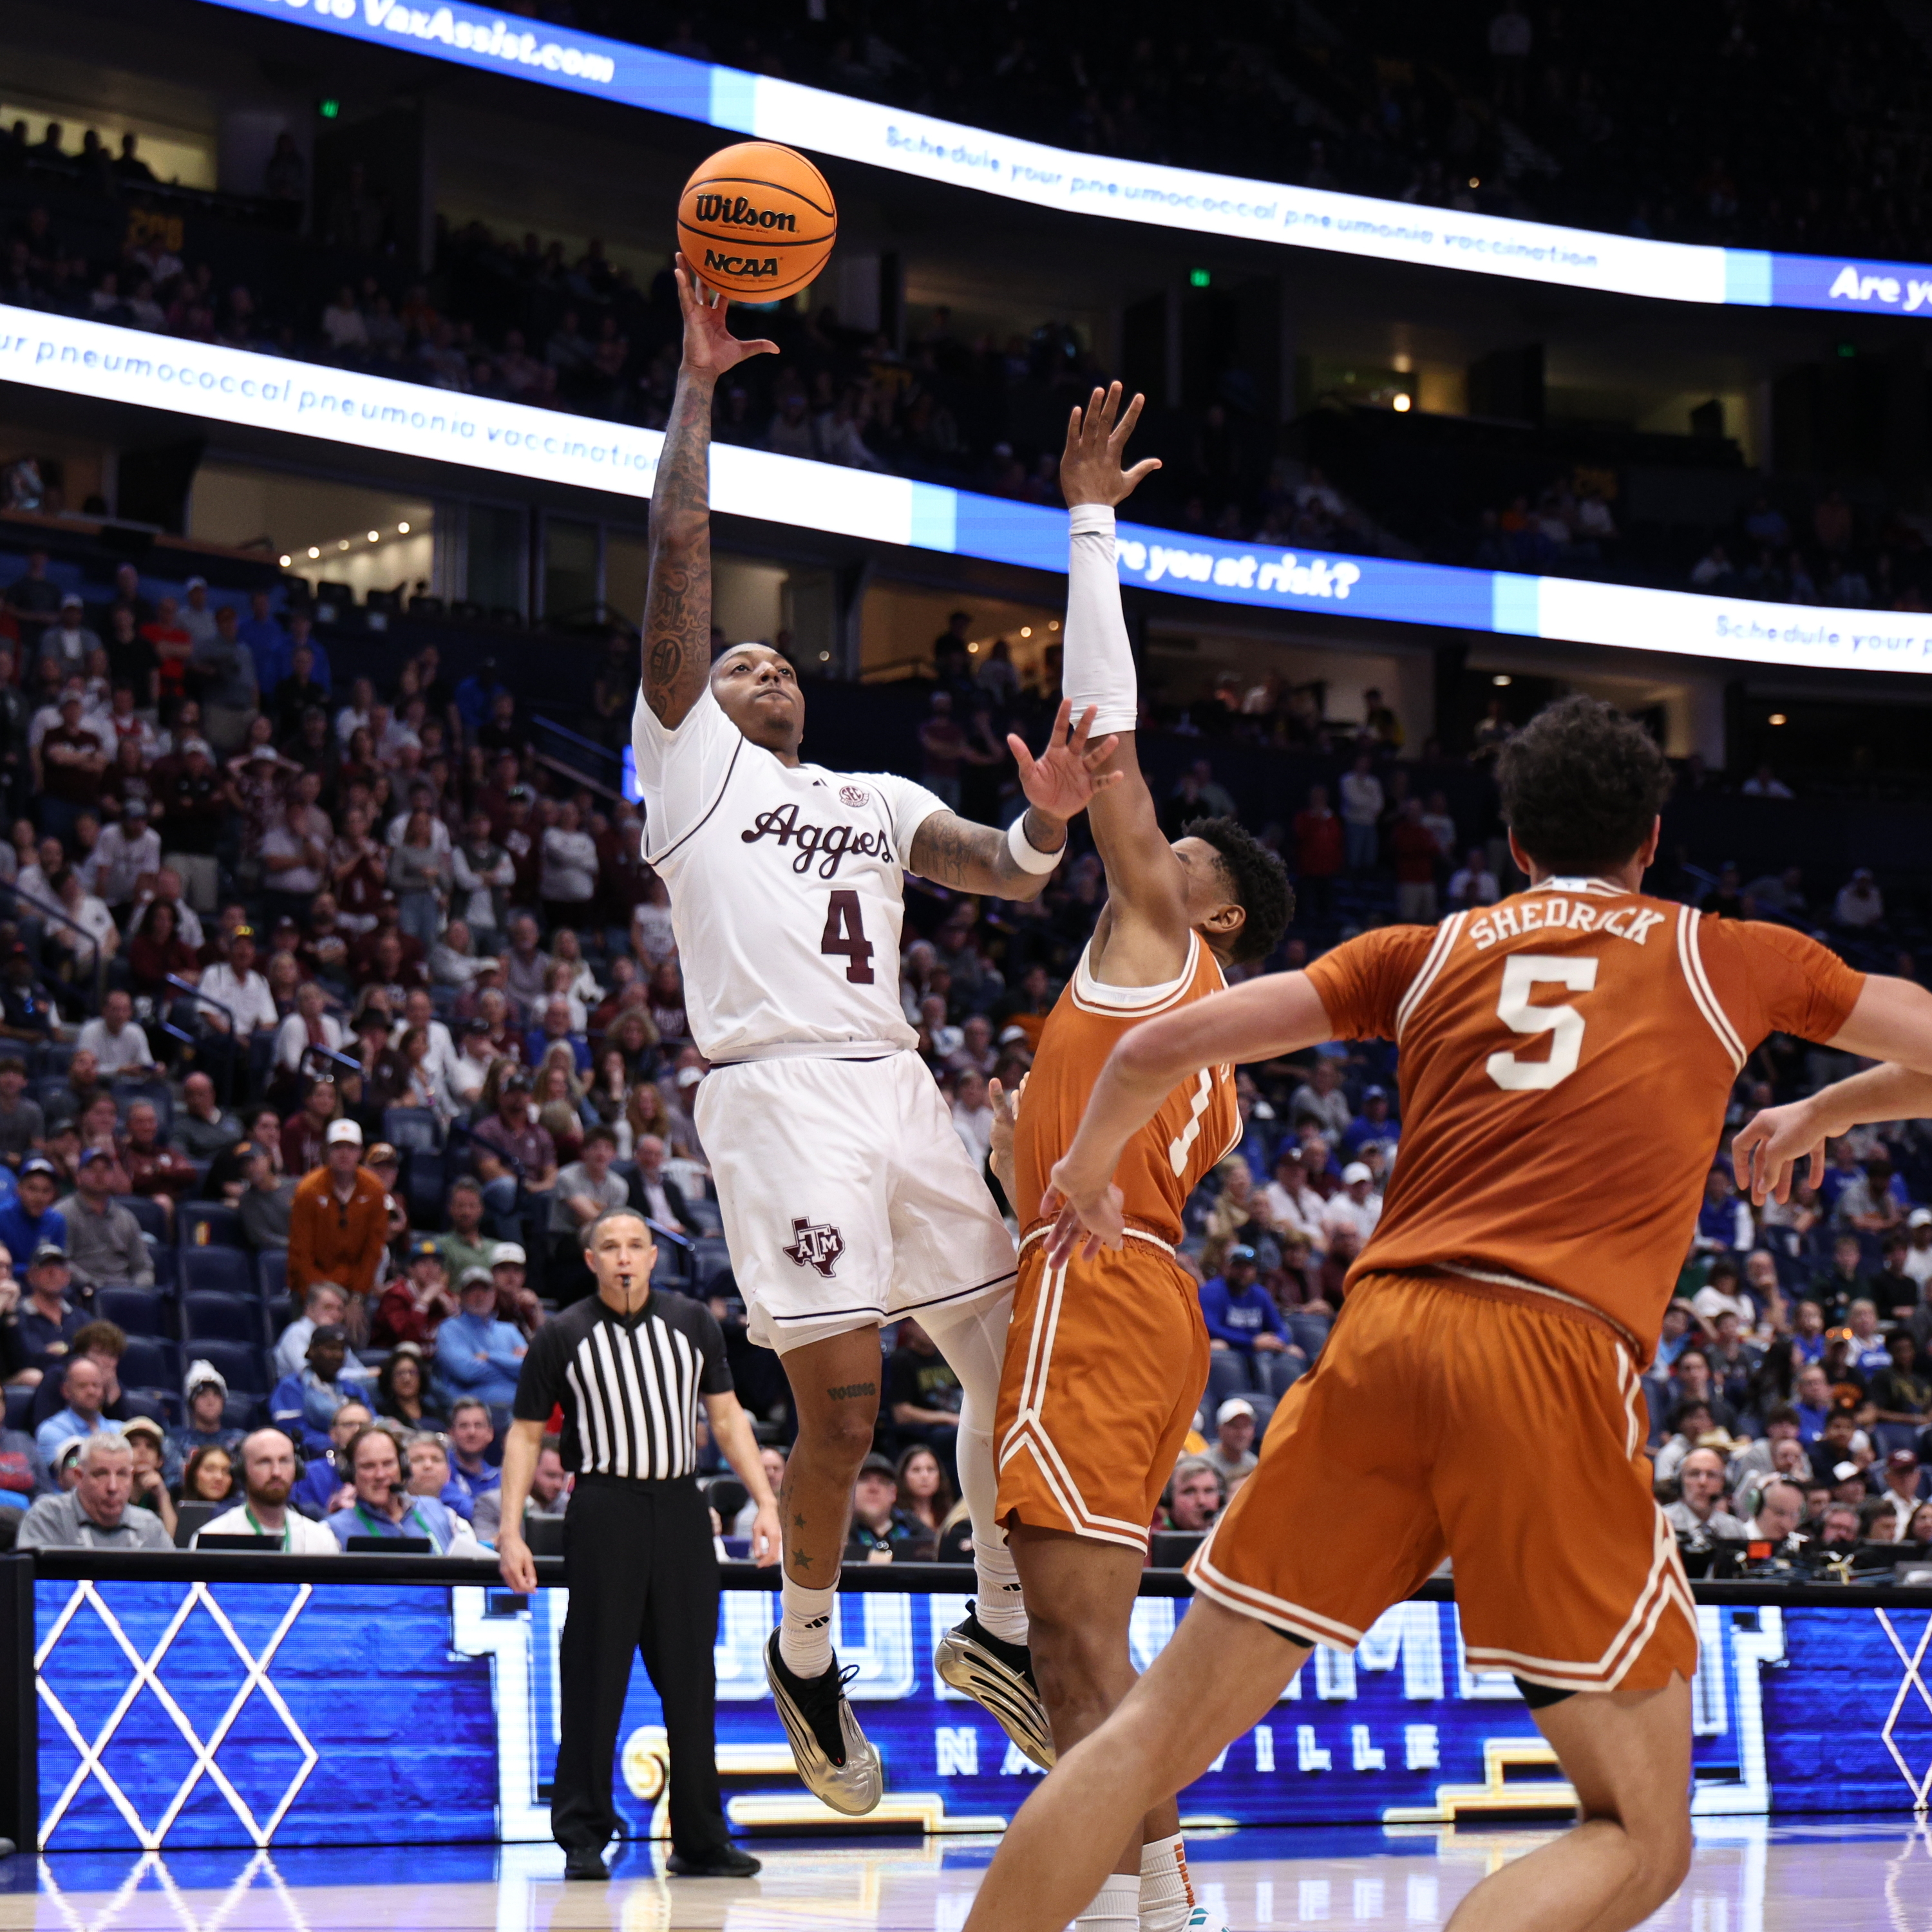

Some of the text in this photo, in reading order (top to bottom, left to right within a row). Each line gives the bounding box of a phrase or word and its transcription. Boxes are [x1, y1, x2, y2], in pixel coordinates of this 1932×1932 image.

[363, 0, 614, 83] VaxAssist.com
[696, 194, 797, 232] Wilson
[886, 125, 1598, 268] Schedule your pneumococcal pneumonia vaccination
[704, 249, 779, 278] NCAA
[1829, 265, 1900, 303] Are
[35, 341, 292, 403] pneumococcal
[298, 390, 476, 439] pneumonia
[1115, 538, 1360, 599] re you at risk?
[1715, 614, 1840, 647] Schedule
[1852, 635, 1915, 654] your
[841, 786, 862, 801] SEC
[741, 804, 894, 880] Aggies
[821, 890, 875, 985] 4
[1469, 898, 1665, 950] SHEDRICK
[1486, 954, 1598, 1090] 5
[935, 1724, 1440, 1776] NILLE
